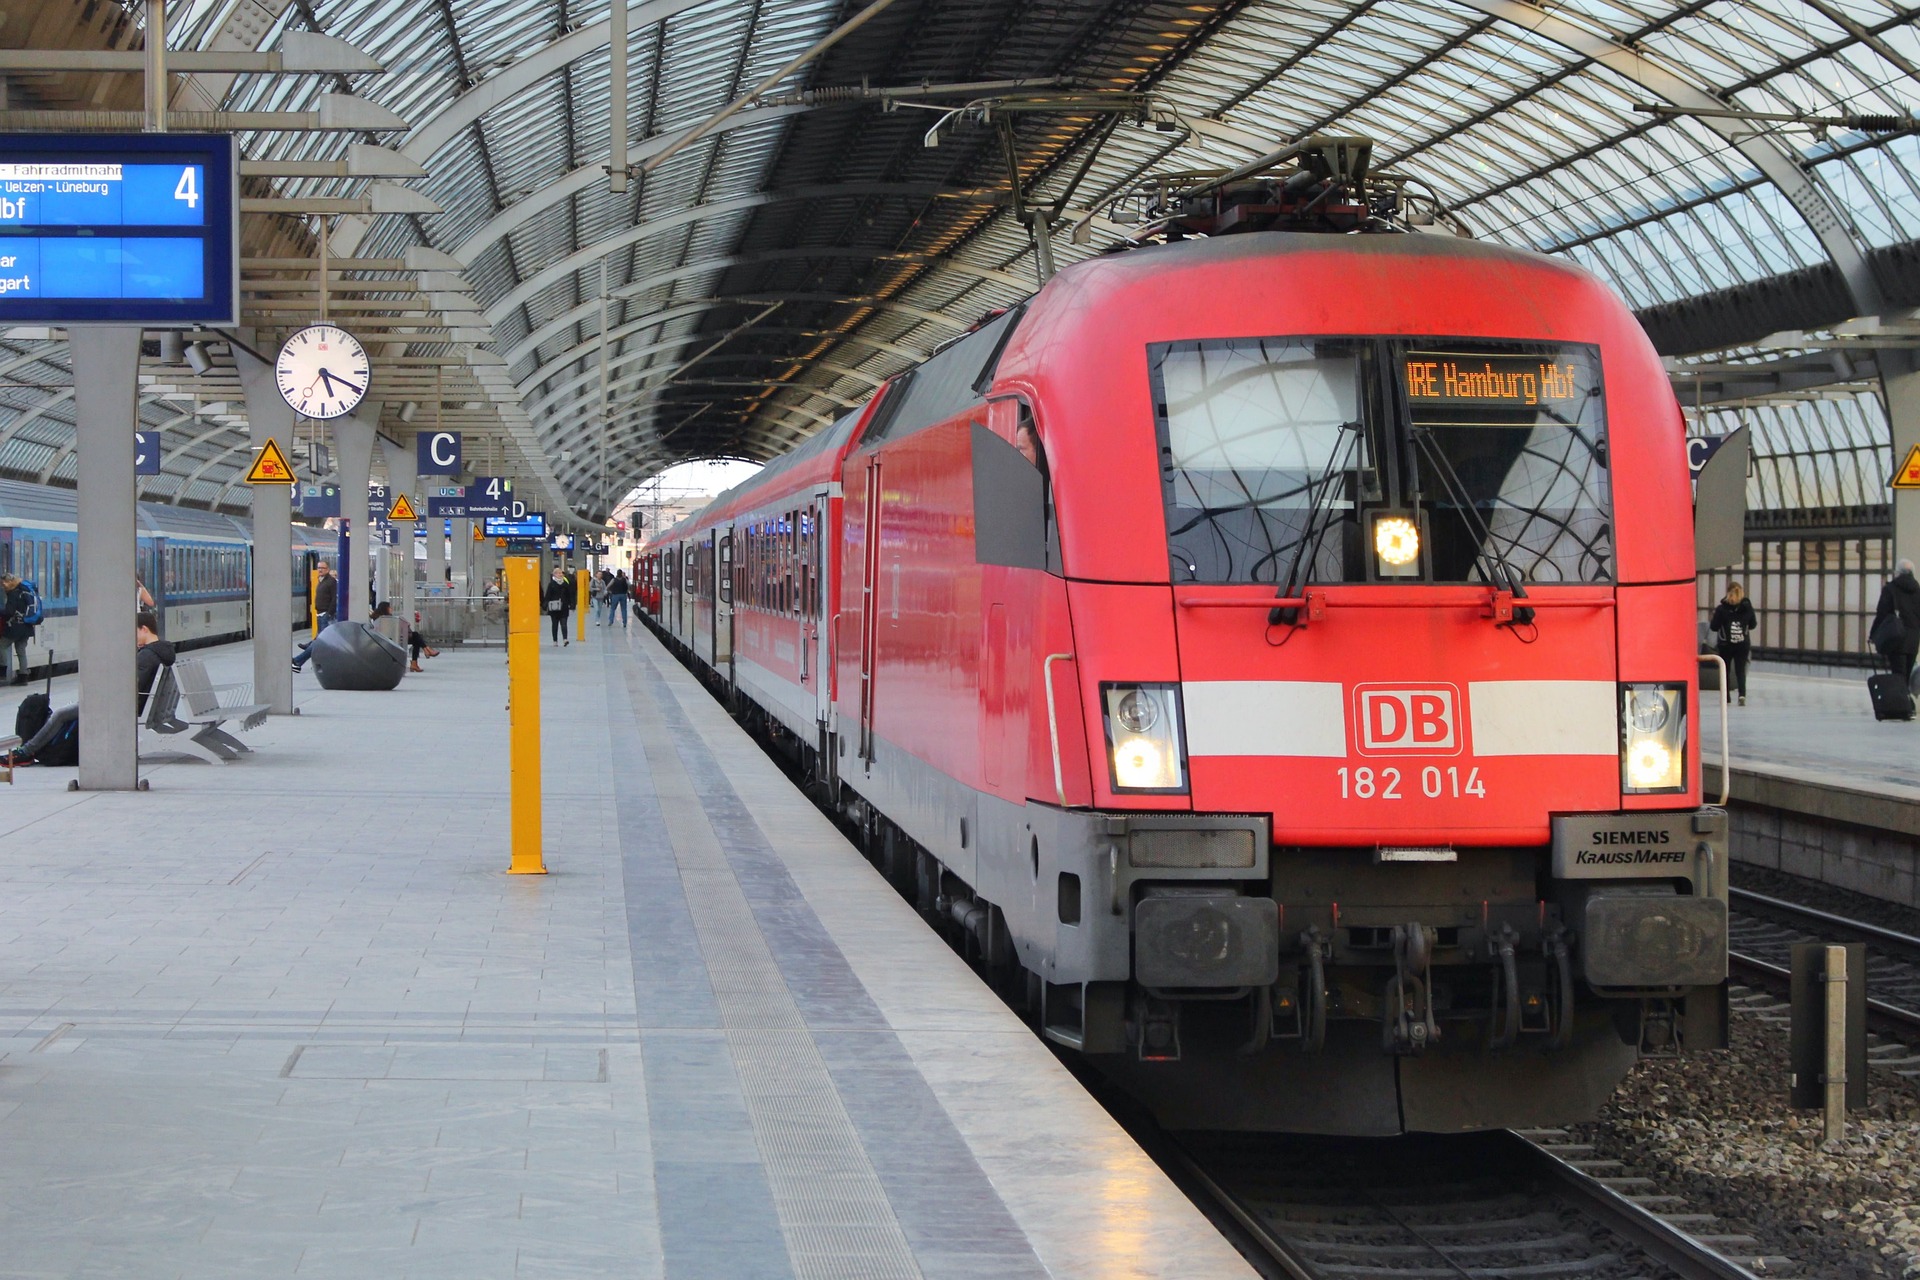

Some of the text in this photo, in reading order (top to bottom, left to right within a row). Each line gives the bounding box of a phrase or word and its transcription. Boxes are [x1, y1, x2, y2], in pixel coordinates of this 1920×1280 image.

[5, 181, 45, 193] Uelzen
[56, 181, 108, 196] Lüneburg
[174, 166, 199, 208] 4
[0, 197, 26, 219] bf
[1407, 362, 1575, 405] IRE Hamburg Hbf
[431, 432, 456, 466] C
[1686, 438, 1708, 471] C
[486, 478, 501, 500] 4
[512, 501, 525, 518] D
[1368, 694, 1449, 743] DB
[1337, 765, 1486, 799] 182 014
[1592, 830, 1670, 845] SIEMENS
